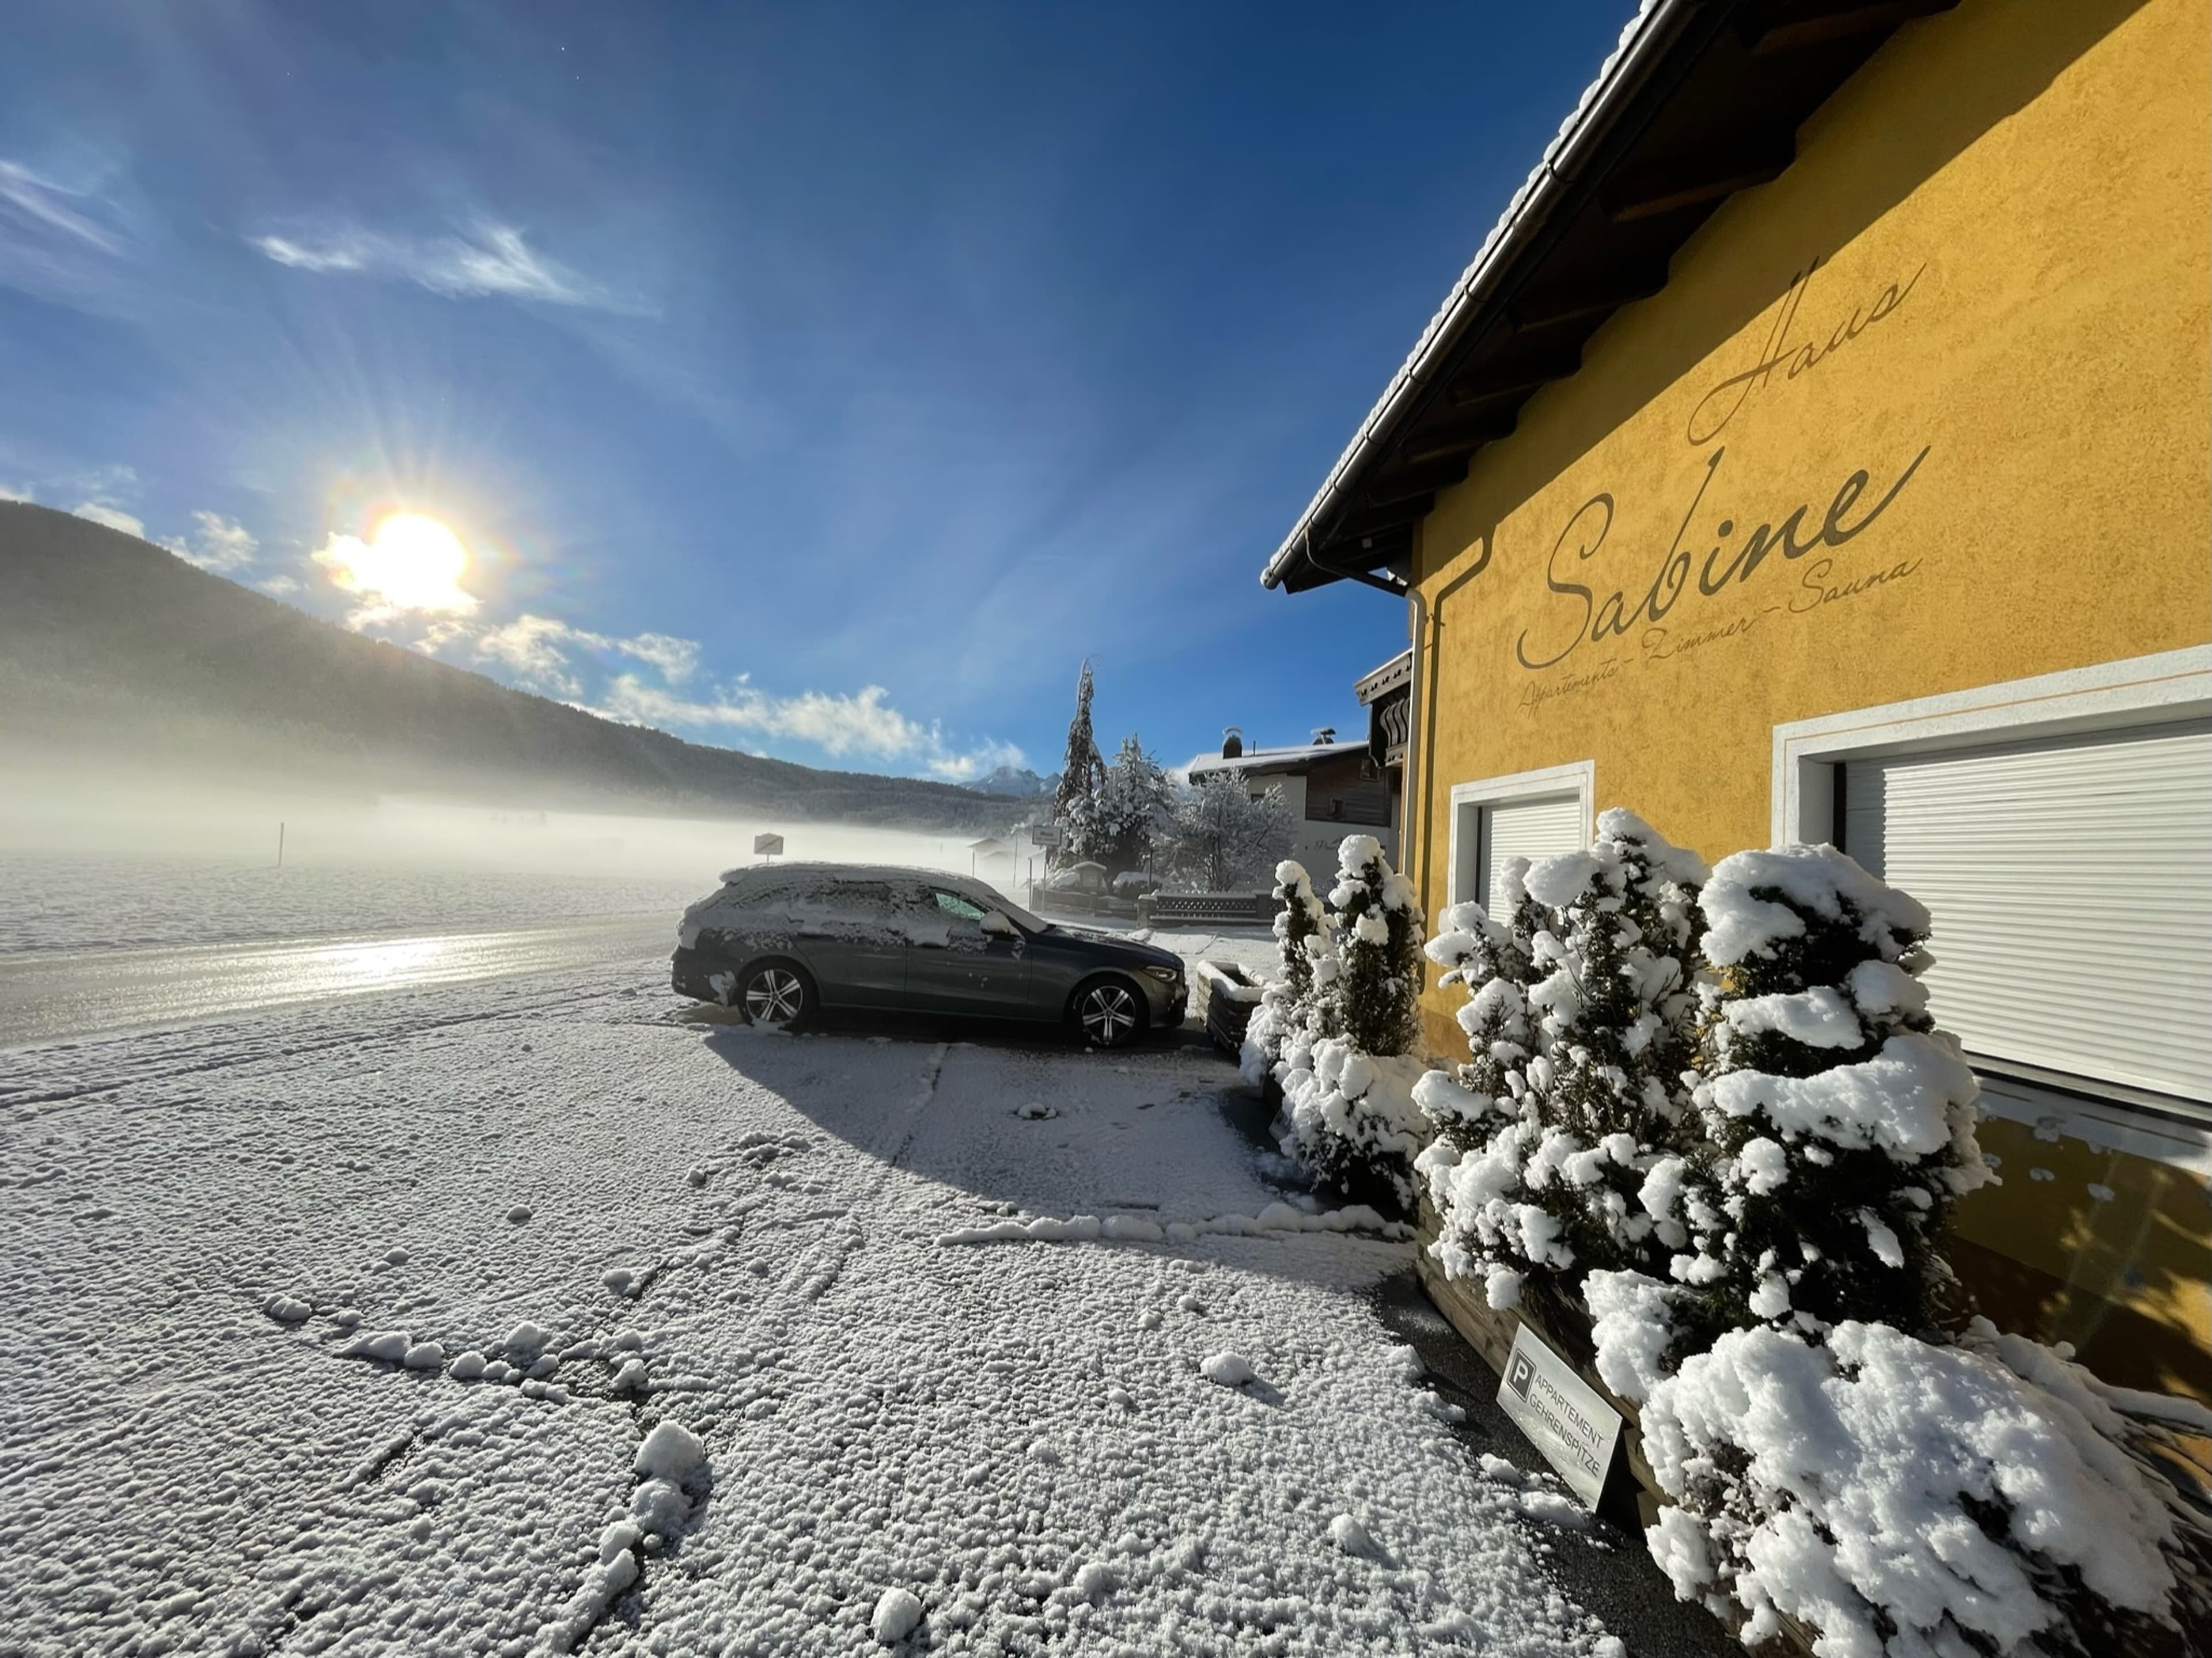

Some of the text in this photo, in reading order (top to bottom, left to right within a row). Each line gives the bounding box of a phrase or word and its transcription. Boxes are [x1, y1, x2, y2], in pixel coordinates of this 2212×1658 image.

[1687, 256, 1927, 446] Haus
[1516, 445, 1931, 669] Sabine
[1641, 617, 1758, 664] Zimmer
[1788, 557, 1924, 613] Sauna
[1513, 1360, 1529, 1383] P
[1534, 1374, 1605, 1448] APPARTEMENT
[1529, 1393, 1601, 1478] GEHRENSPITZE
